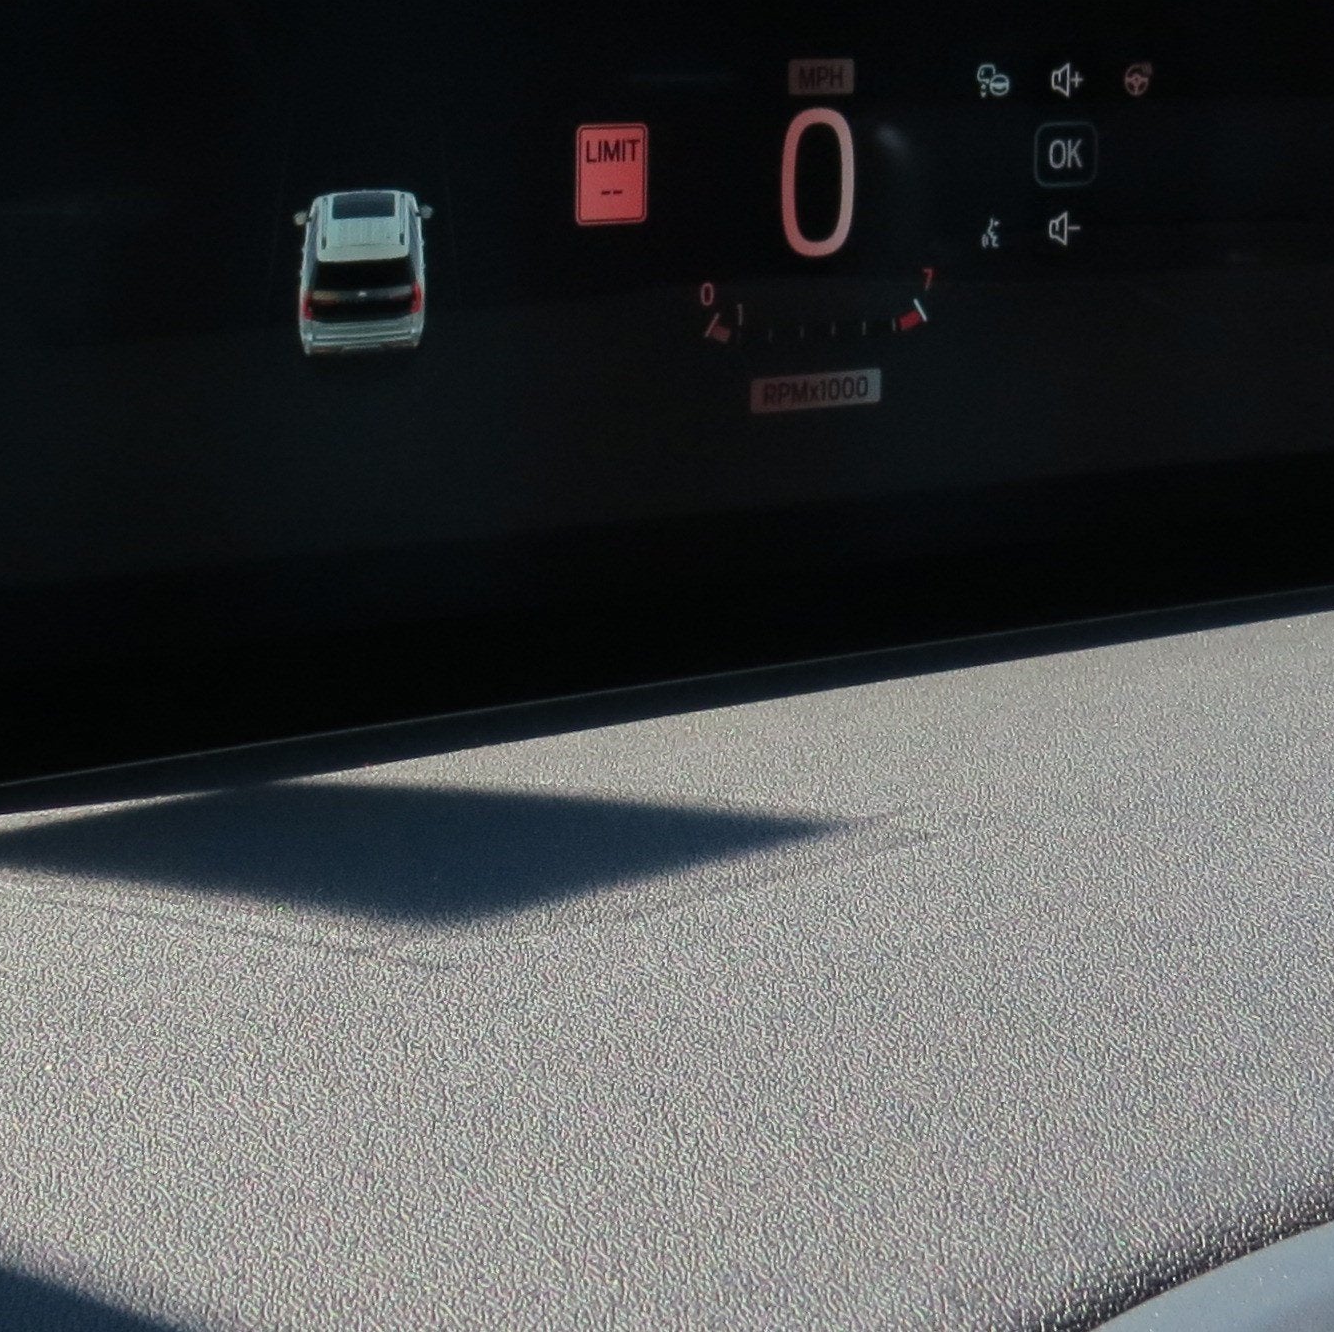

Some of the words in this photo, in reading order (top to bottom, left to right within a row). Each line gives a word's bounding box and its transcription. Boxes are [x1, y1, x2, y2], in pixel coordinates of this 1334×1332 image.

[797, 65, 845, 89] MPH
[584, 138, 641, 165] LIMIT
[1048, 138, 1083, 169] OK
[780, 106, 856, 258] 0
[699, 282, 716, 307] 0
